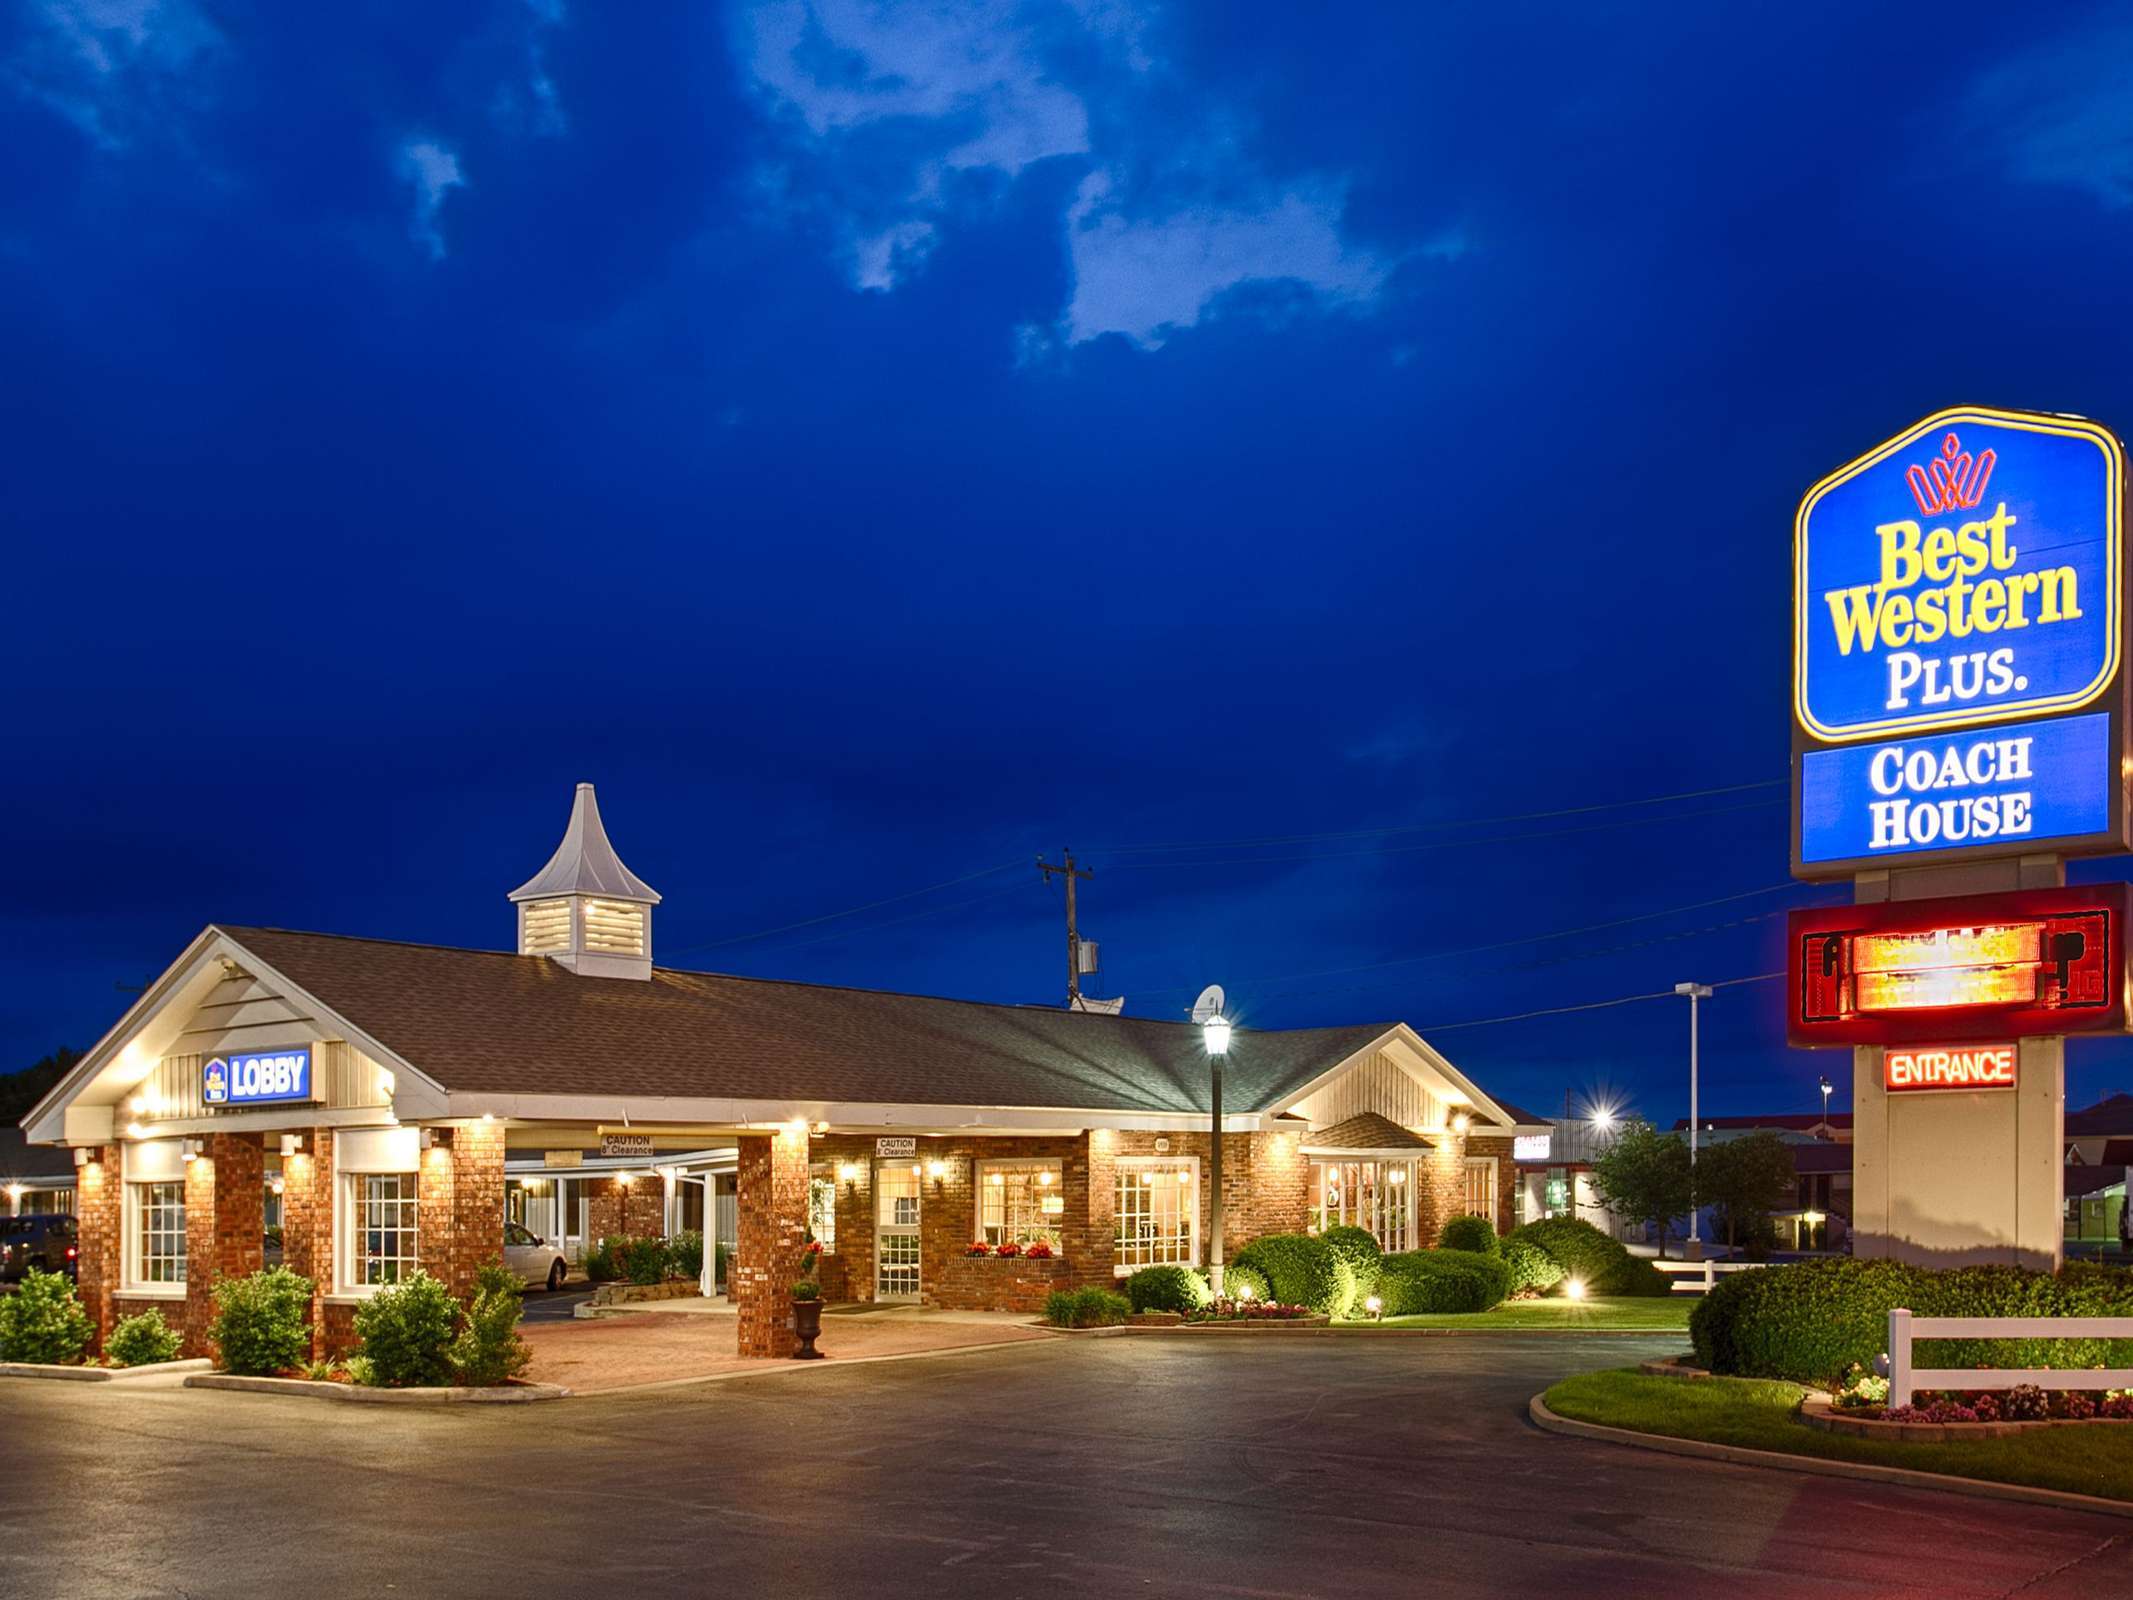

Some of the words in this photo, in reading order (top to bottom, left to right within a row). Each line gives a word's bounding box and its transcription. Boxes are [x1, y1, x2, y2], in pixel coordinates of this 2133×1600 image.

[1876, 502, 2017, 590] Best
[1824, 564, 2083, 656] Western
[1870, 737, 2033, 795] COACH
[1868, 791, 2032, 849] HOUSE
[231, 1056, 306, 1096] LOBBY
[1890, 1051, 2013, 1083] ENTRANCE
[606, 1136, 649, 1144] CAUTION
[611, 1145, 653, 1154] Clearance
[881, 1139, 913, 1148] CAUTION
